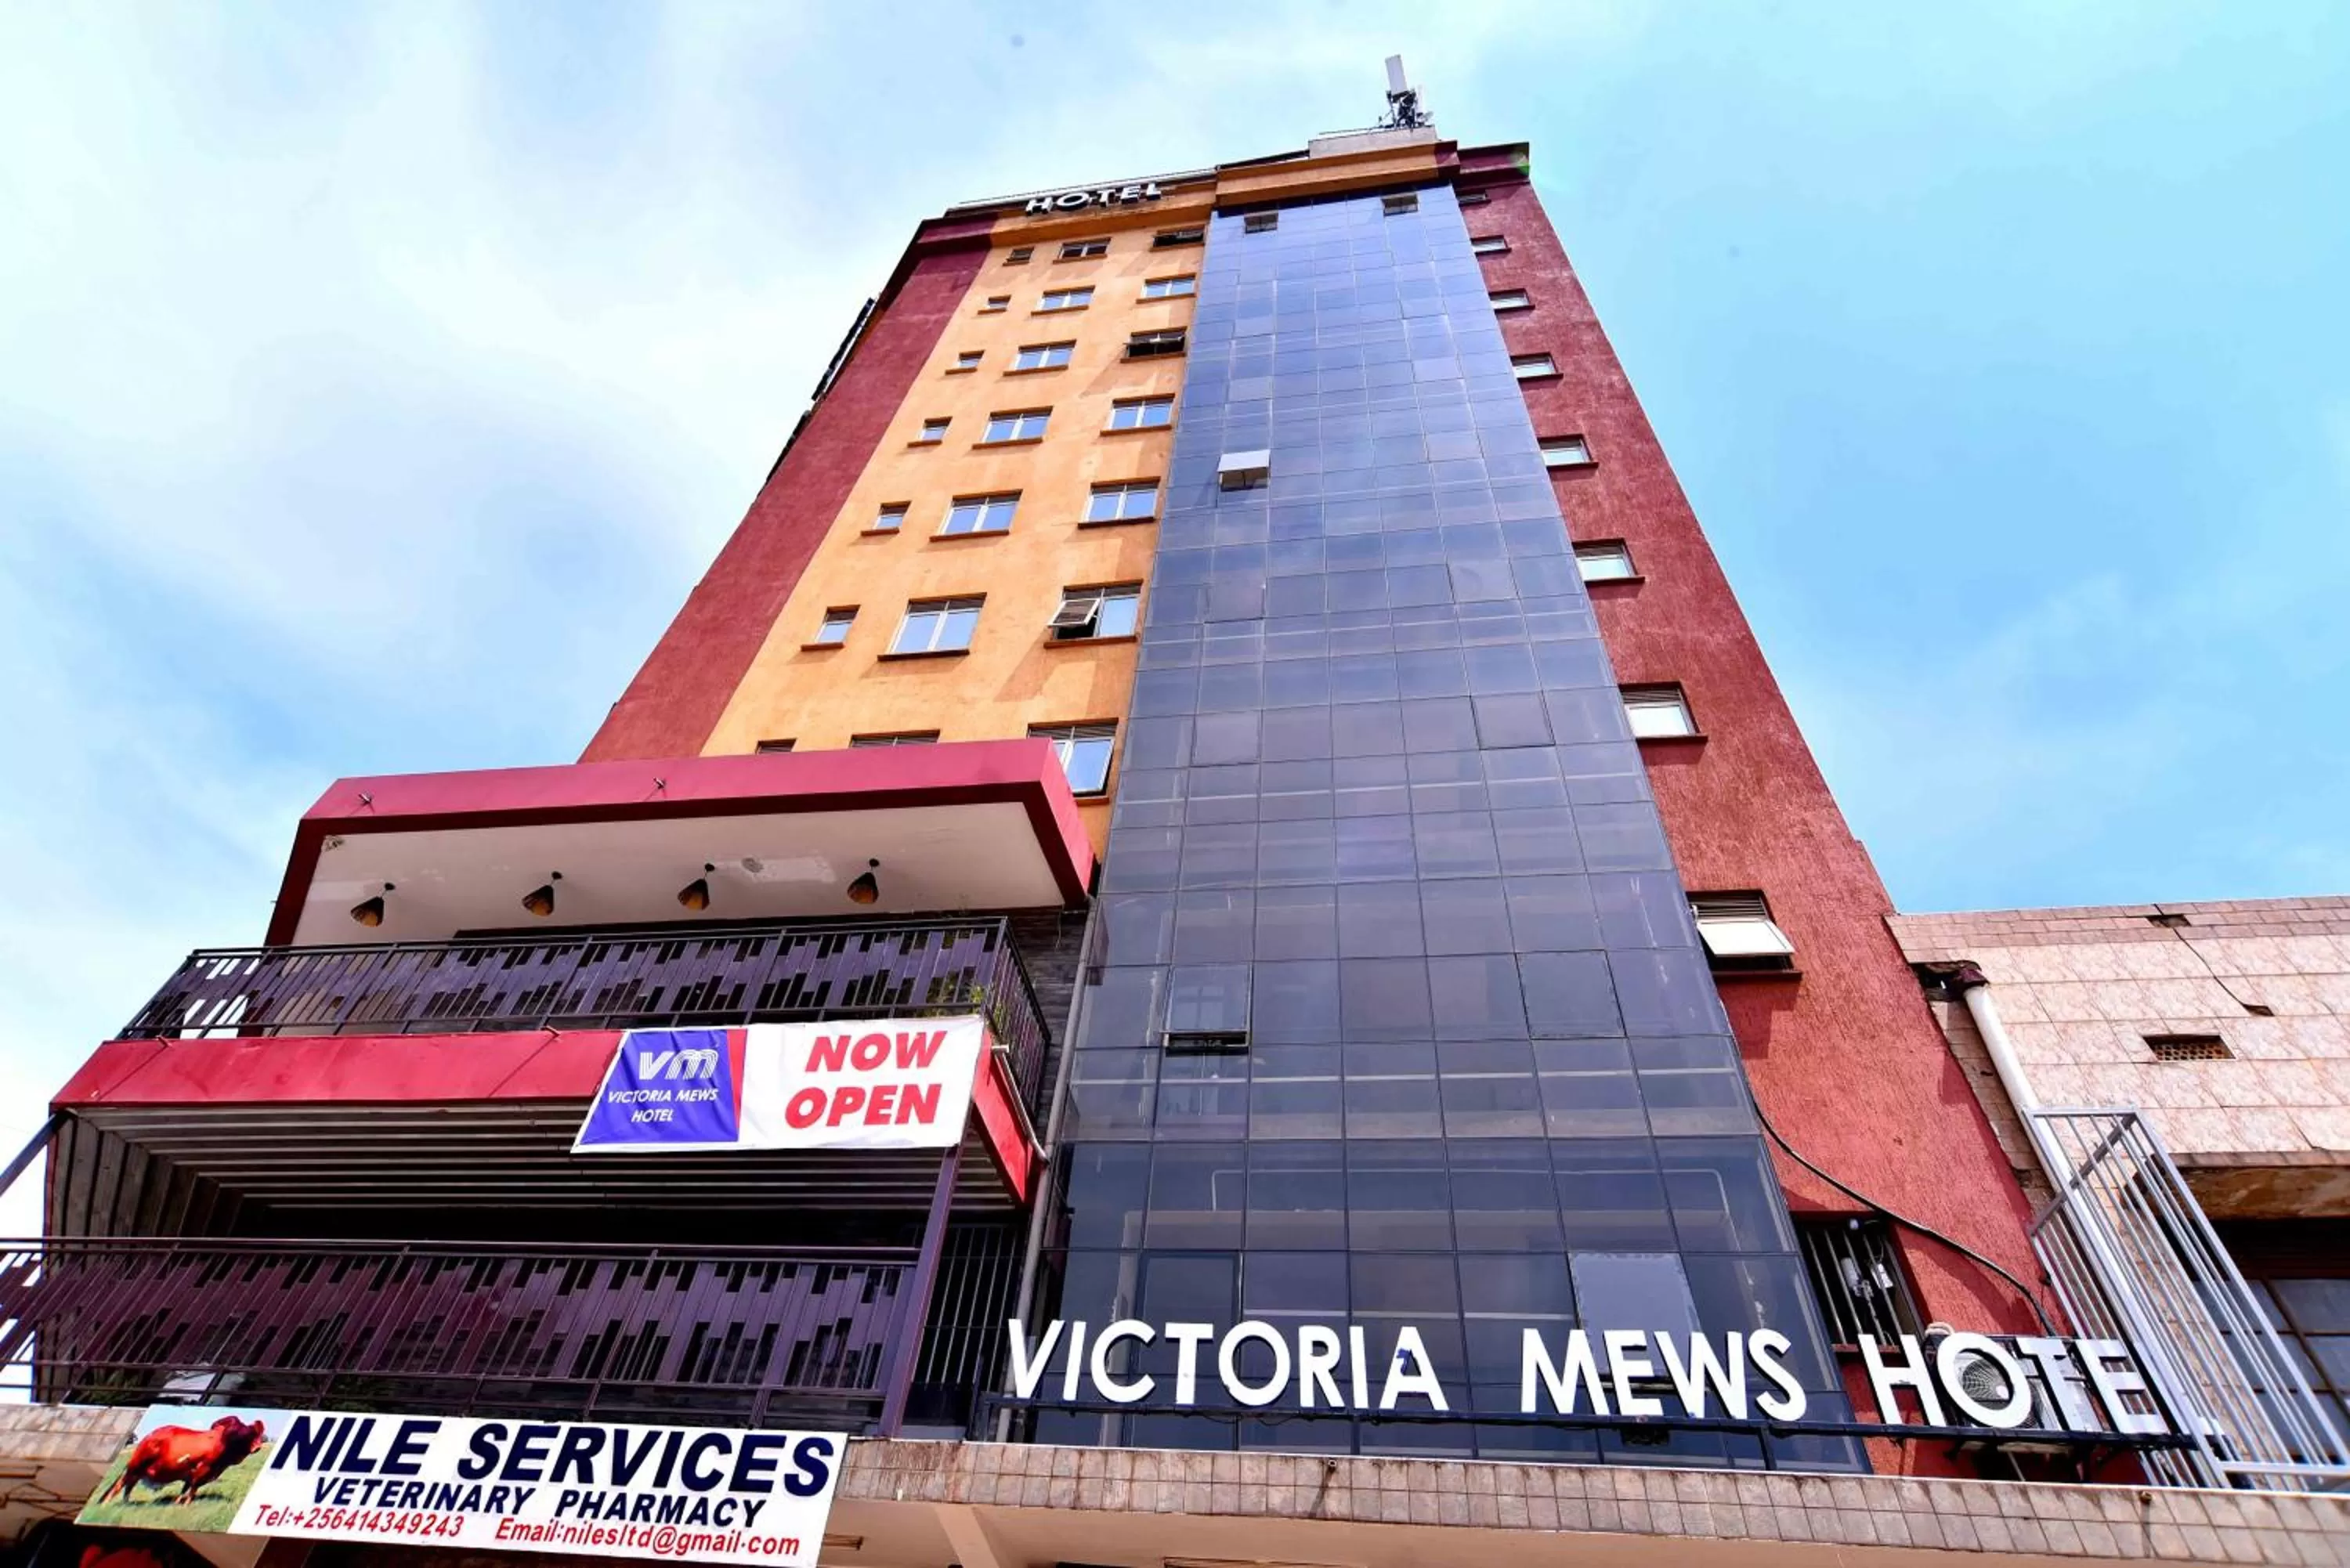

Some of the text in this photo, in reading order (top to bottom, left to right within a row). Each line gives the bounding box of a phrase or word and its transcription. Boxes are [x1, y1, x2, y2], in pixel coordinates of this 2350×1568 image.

[1025, 183, 1162, 214] HOTEL
[805, 1031, 946, 1072] NOW
[607, 1088, 719, 1104] VICTORIA MEWS
[631, 1108, 674, 1122] HOTEL
[785, 1083, 942, 1129] OPEN
[1008, 1317, 1449, 1411] VICTORIA
[1520, 1328, 1808, 1422] MEWS
[269, 1414, 835, 1498] NILE SERVICES
[254, 1504, 465, 1537] Tel:+256414349243
[313, 1476, 767, 1529] VETERINARY PHARMACY
